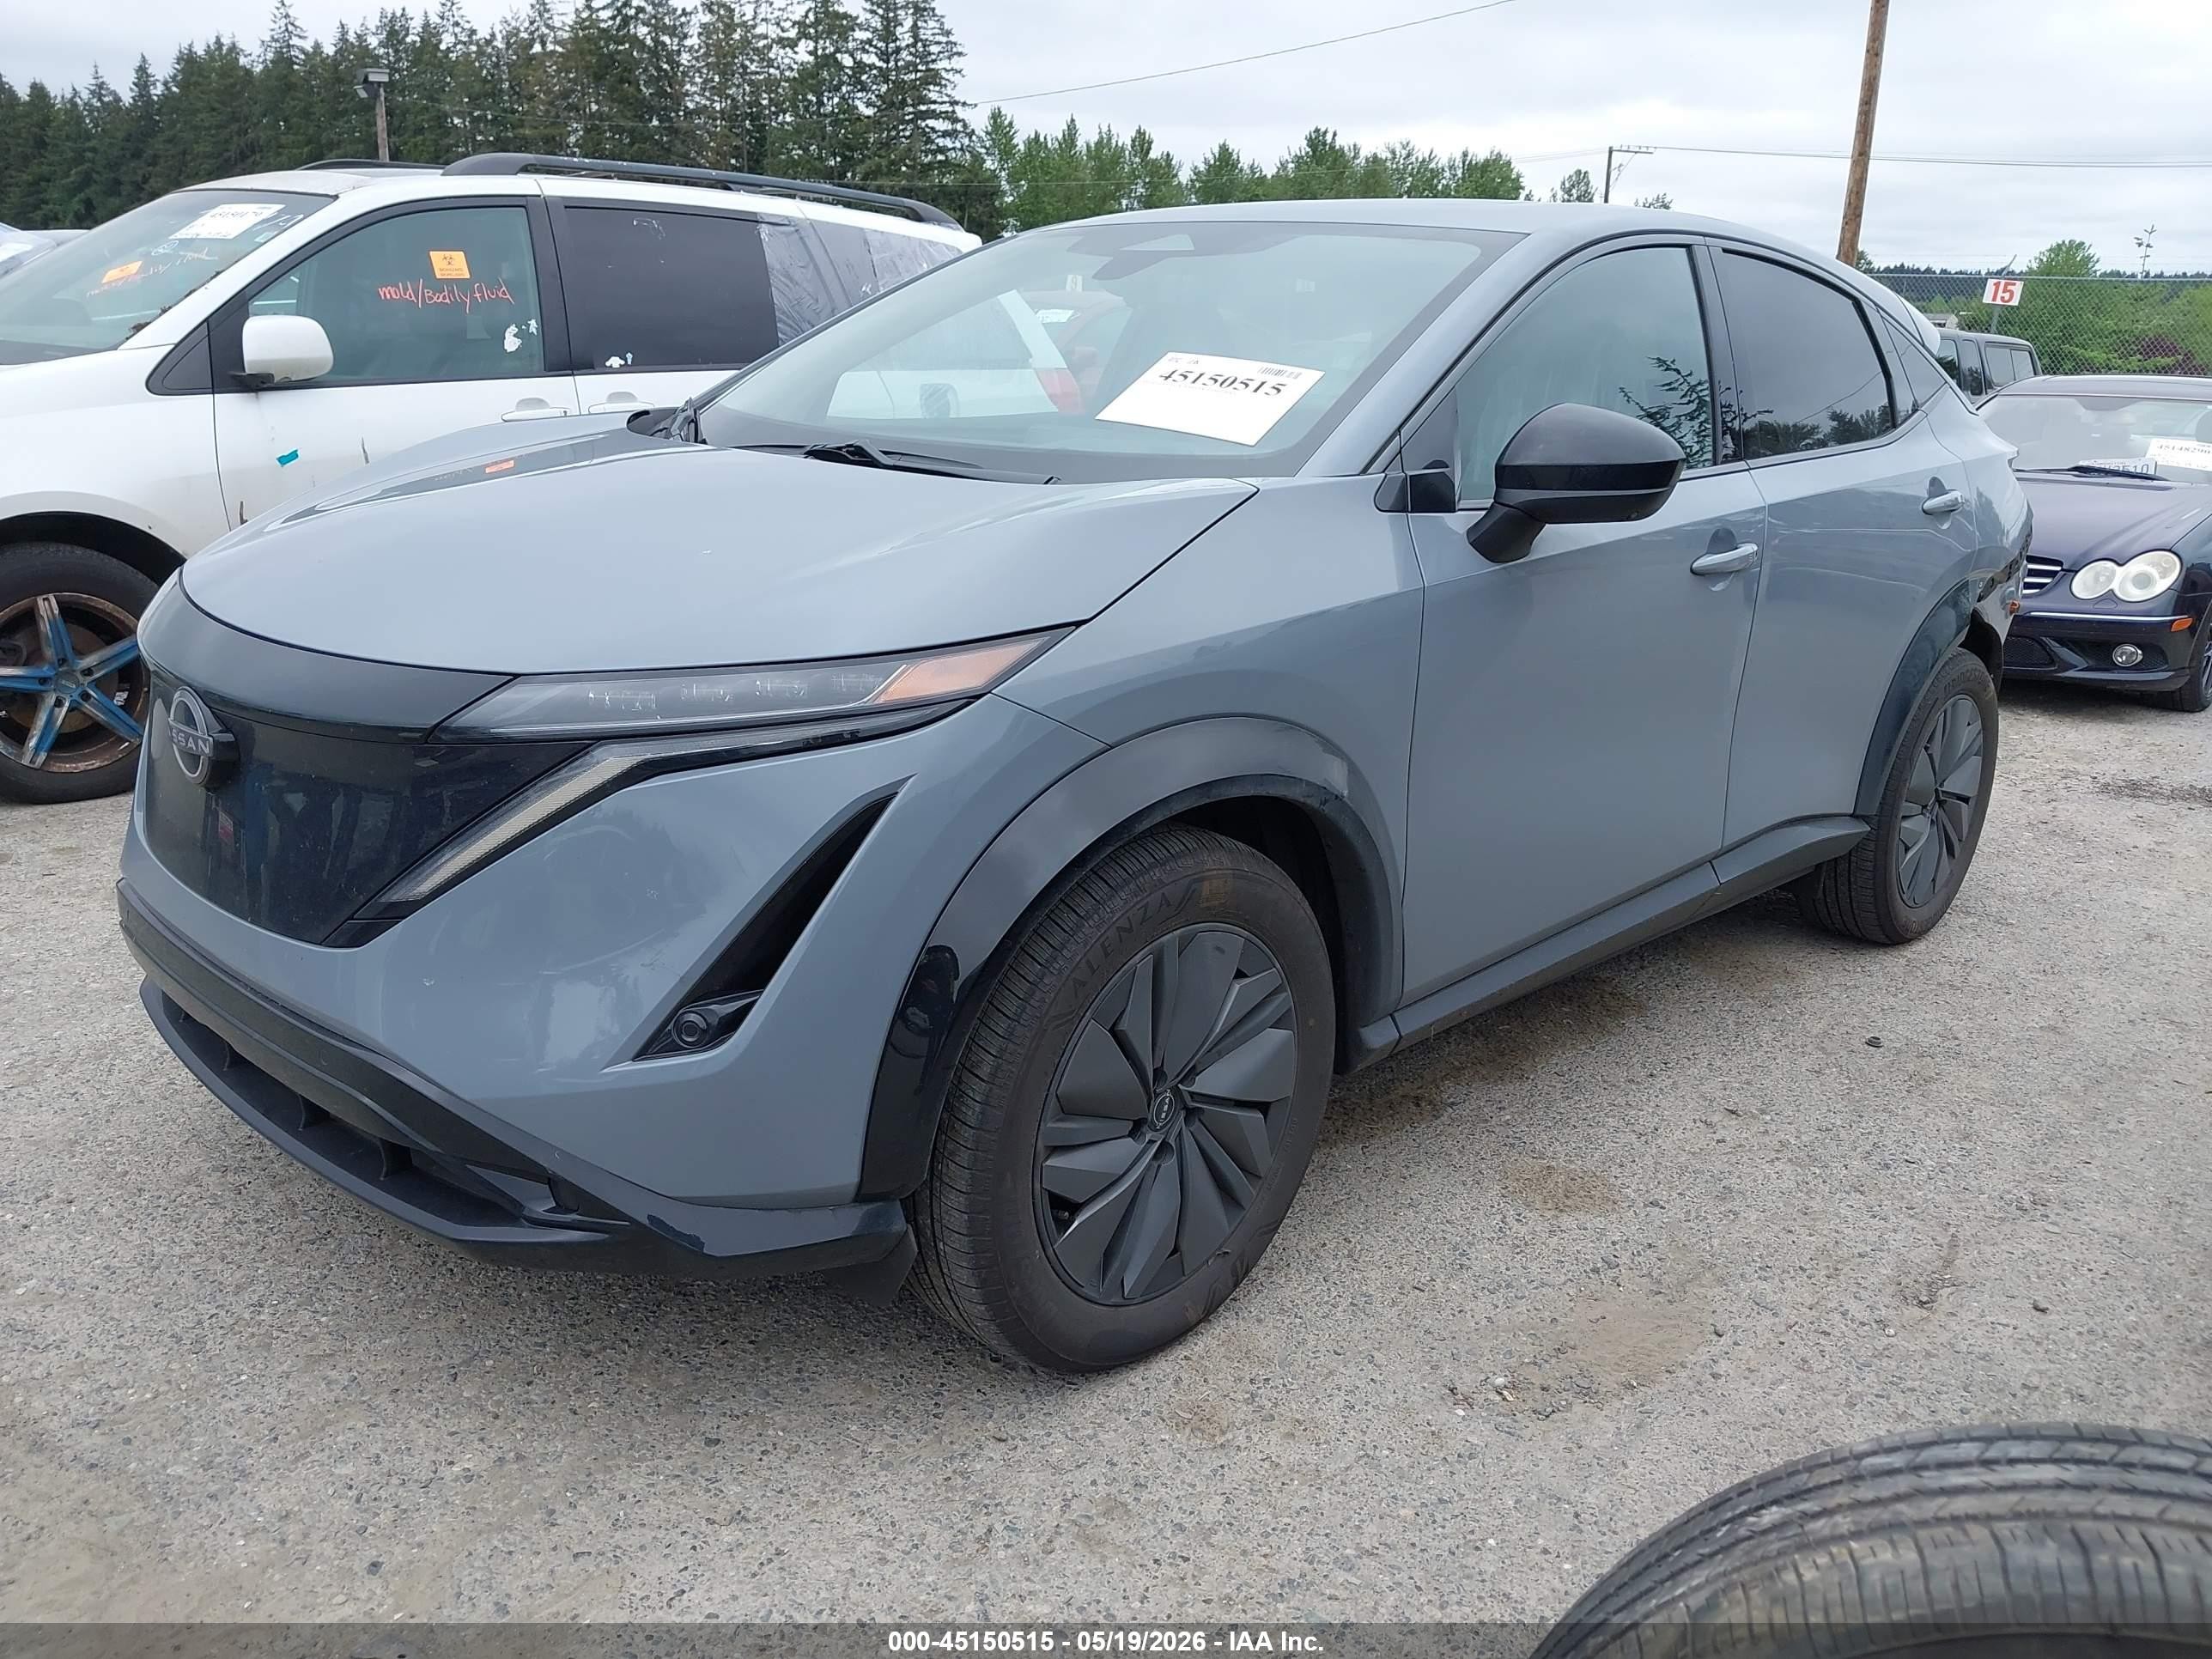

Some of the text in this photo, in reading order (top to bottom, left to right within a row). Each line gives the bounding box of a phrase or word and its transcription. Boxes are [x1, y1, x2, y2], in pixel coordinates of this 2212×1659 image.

[472, 276, 515, 306] fluid
[1991, 280, 2016, 303] 15
[1159, 369, 1287, 397] 45150515
[172, 727, 210, 754] SSAN
